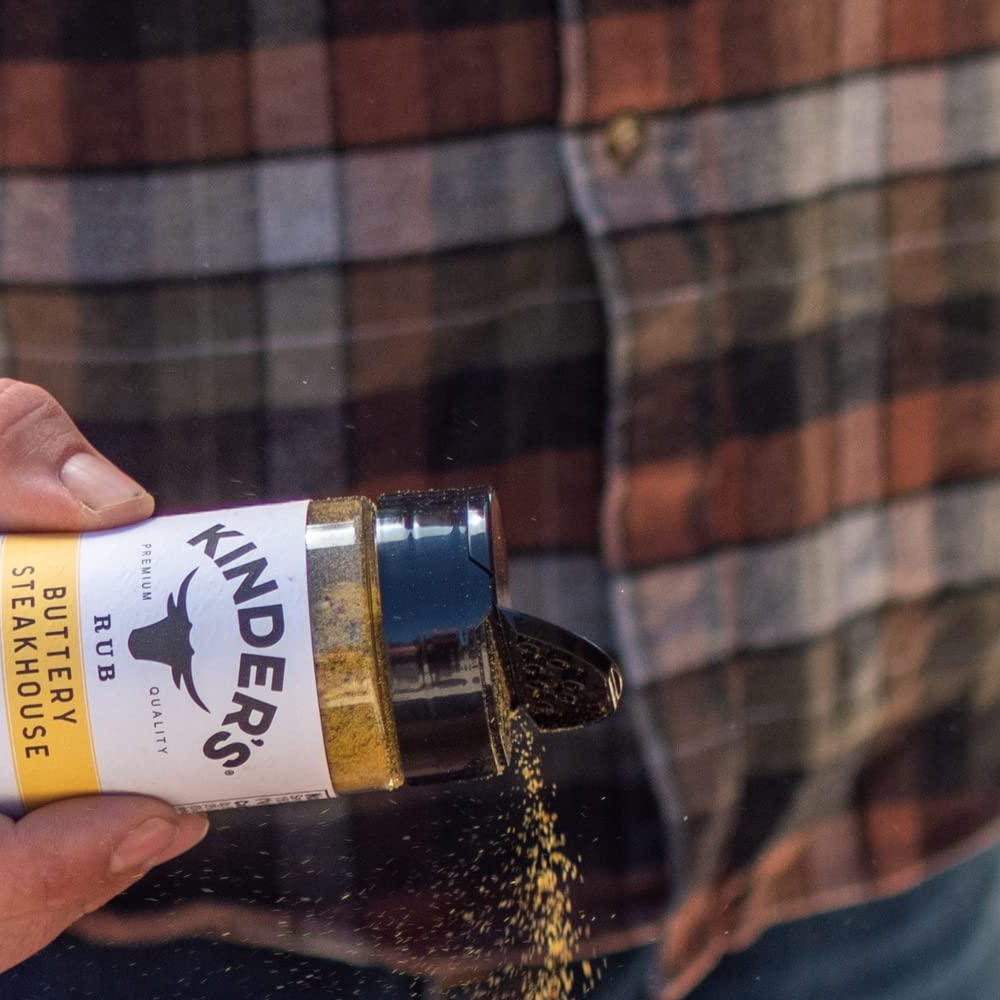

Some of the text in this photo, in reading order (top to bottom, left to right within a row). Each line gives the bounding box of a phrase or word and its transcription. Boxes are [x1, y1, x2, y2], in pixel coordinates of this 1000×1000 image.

[11, 565, 50, 759] STEAKHOUSE
[43, 586, 77, 724] BUTTERY
[94, 614, 116, 682] RUB
[141, 543, 168, 755] PREMIUM QUALITY
[187, 523, 286, 768] KINDER'S
